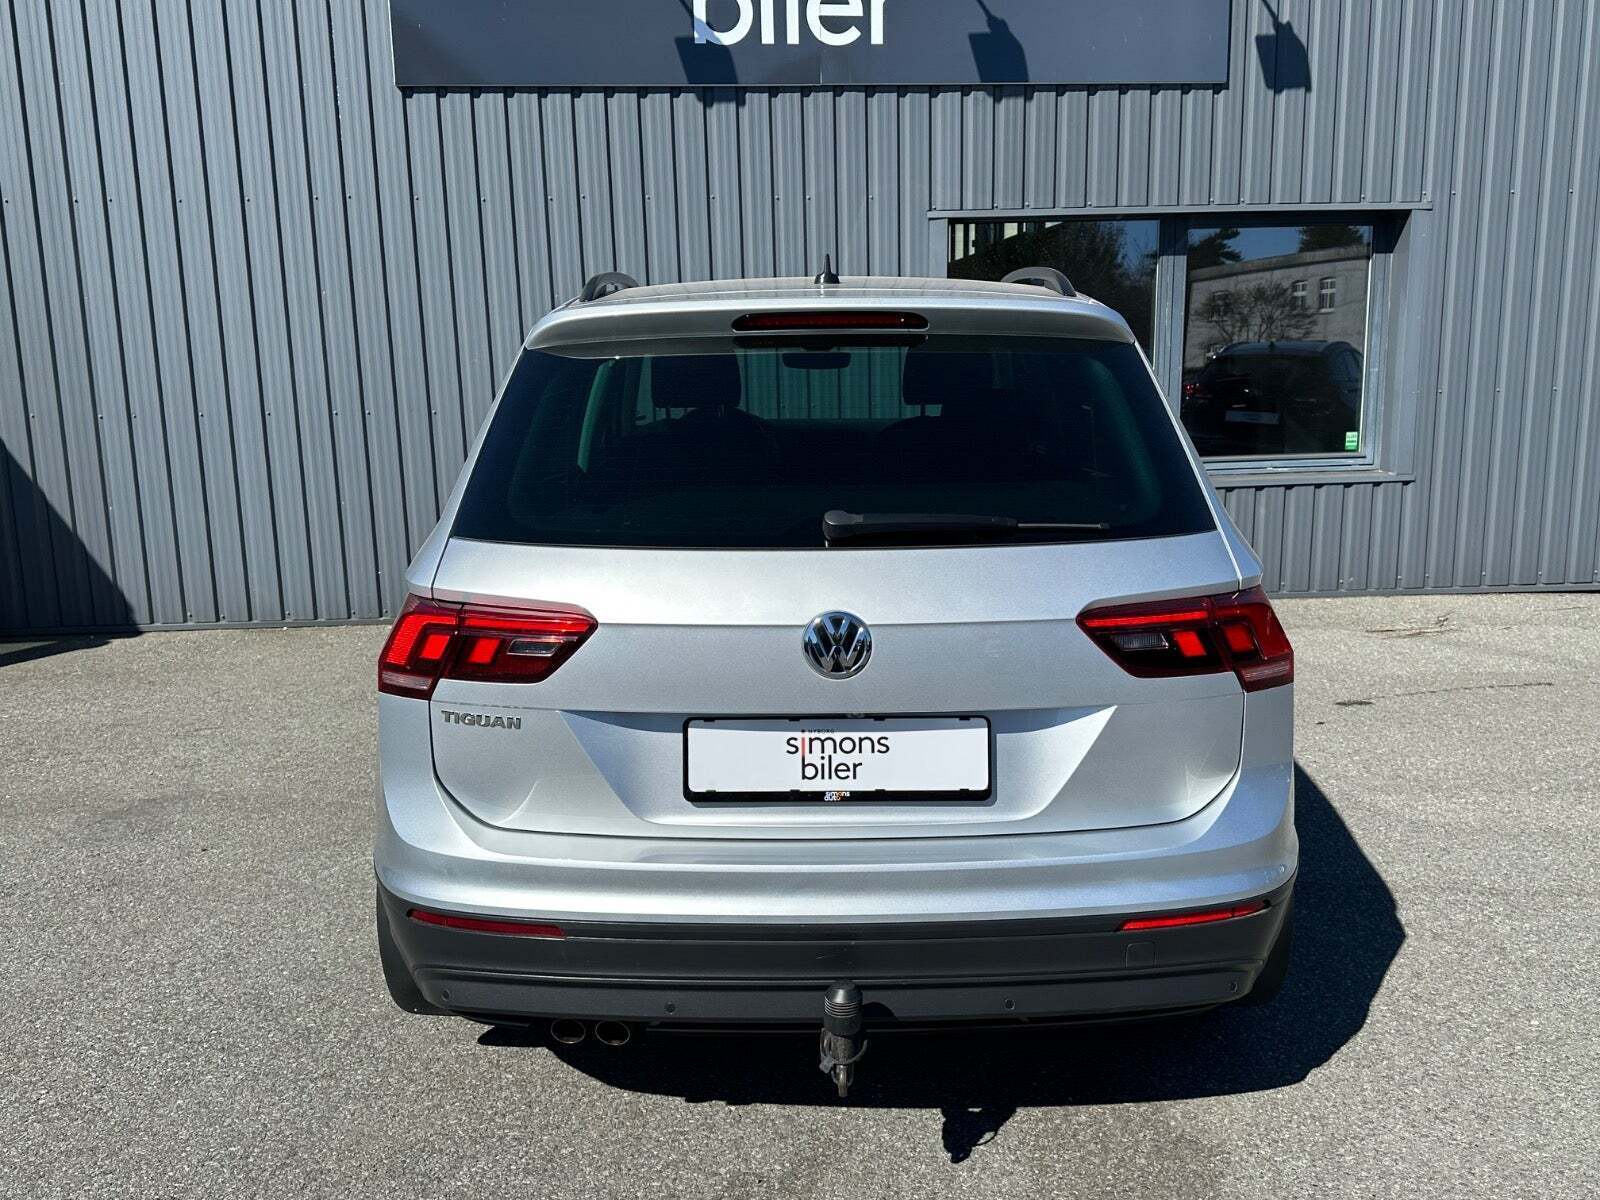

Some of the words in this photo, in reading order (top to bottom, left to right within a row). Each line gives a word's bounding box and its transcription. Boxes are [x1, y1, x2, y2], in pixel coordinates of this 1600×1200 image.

[693, 0, 885, 46] biler
[441, 710, 522, 730] TIGUAN
[786, 730, 890, 755] simons
[801, 754, 863, 780] biler
